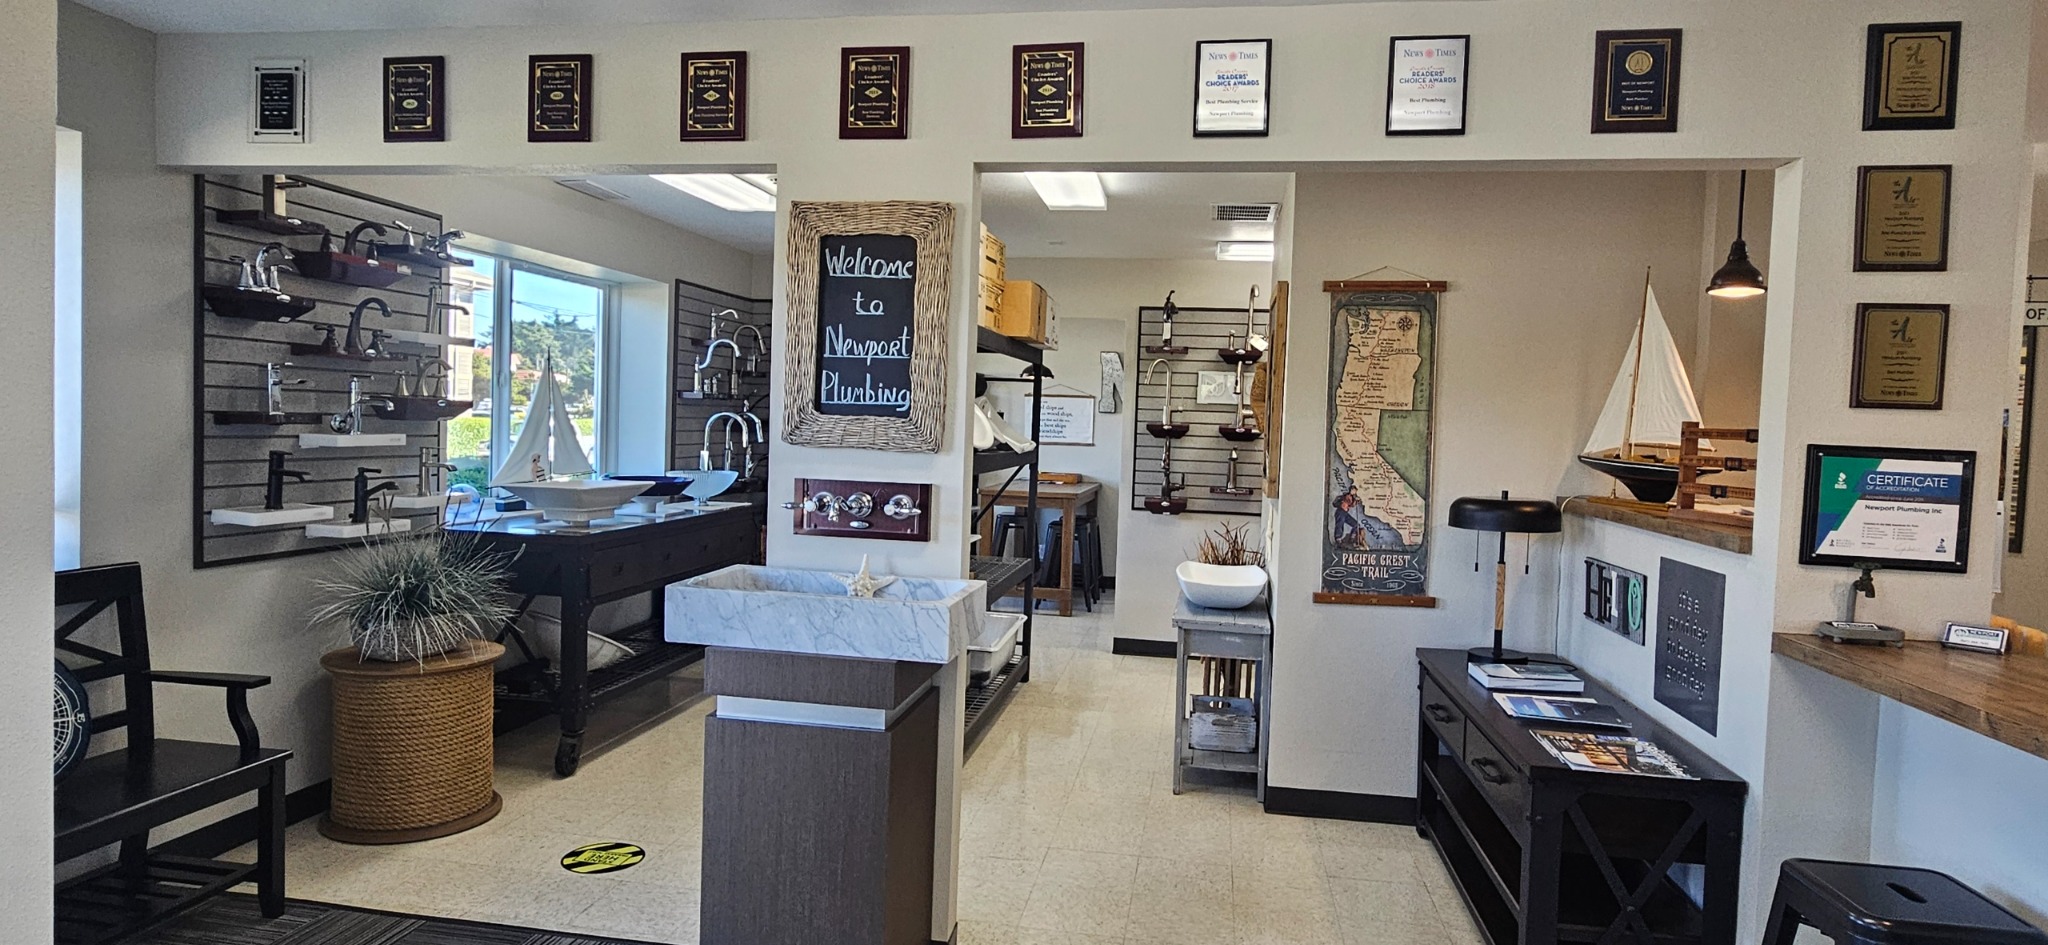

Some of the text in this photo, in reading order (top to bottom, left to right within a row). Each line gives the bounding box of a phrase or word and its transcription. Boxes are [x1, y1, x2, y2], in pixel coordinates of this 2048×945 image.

[1209, 51, 1258, 61] NEWS TIMES
[1403, 48, 1456, 58] NEWS TIMES
[825, 245, 914, 276] Welcome
[852, 291, 884, 312] to
[2026, 308, 2048, 320] OF
[825, 323, 911, 366] Newport
[821, 369, 910, 411] Plumbing
[1867, 474, 1949, 488] CERTIFICATE
[1865, 504, 1896, 512] Newport
[1897, 506, 1930, 514] Plumbing
[1342, 553, 1411, 568] PACIFIC CREST
[1361, 566, 1389, 580] TRAIL
[1667, 616, 1709, 647] good day
[1666, 666, 1705, 700] good day
[76, 712, 85, 723] E
